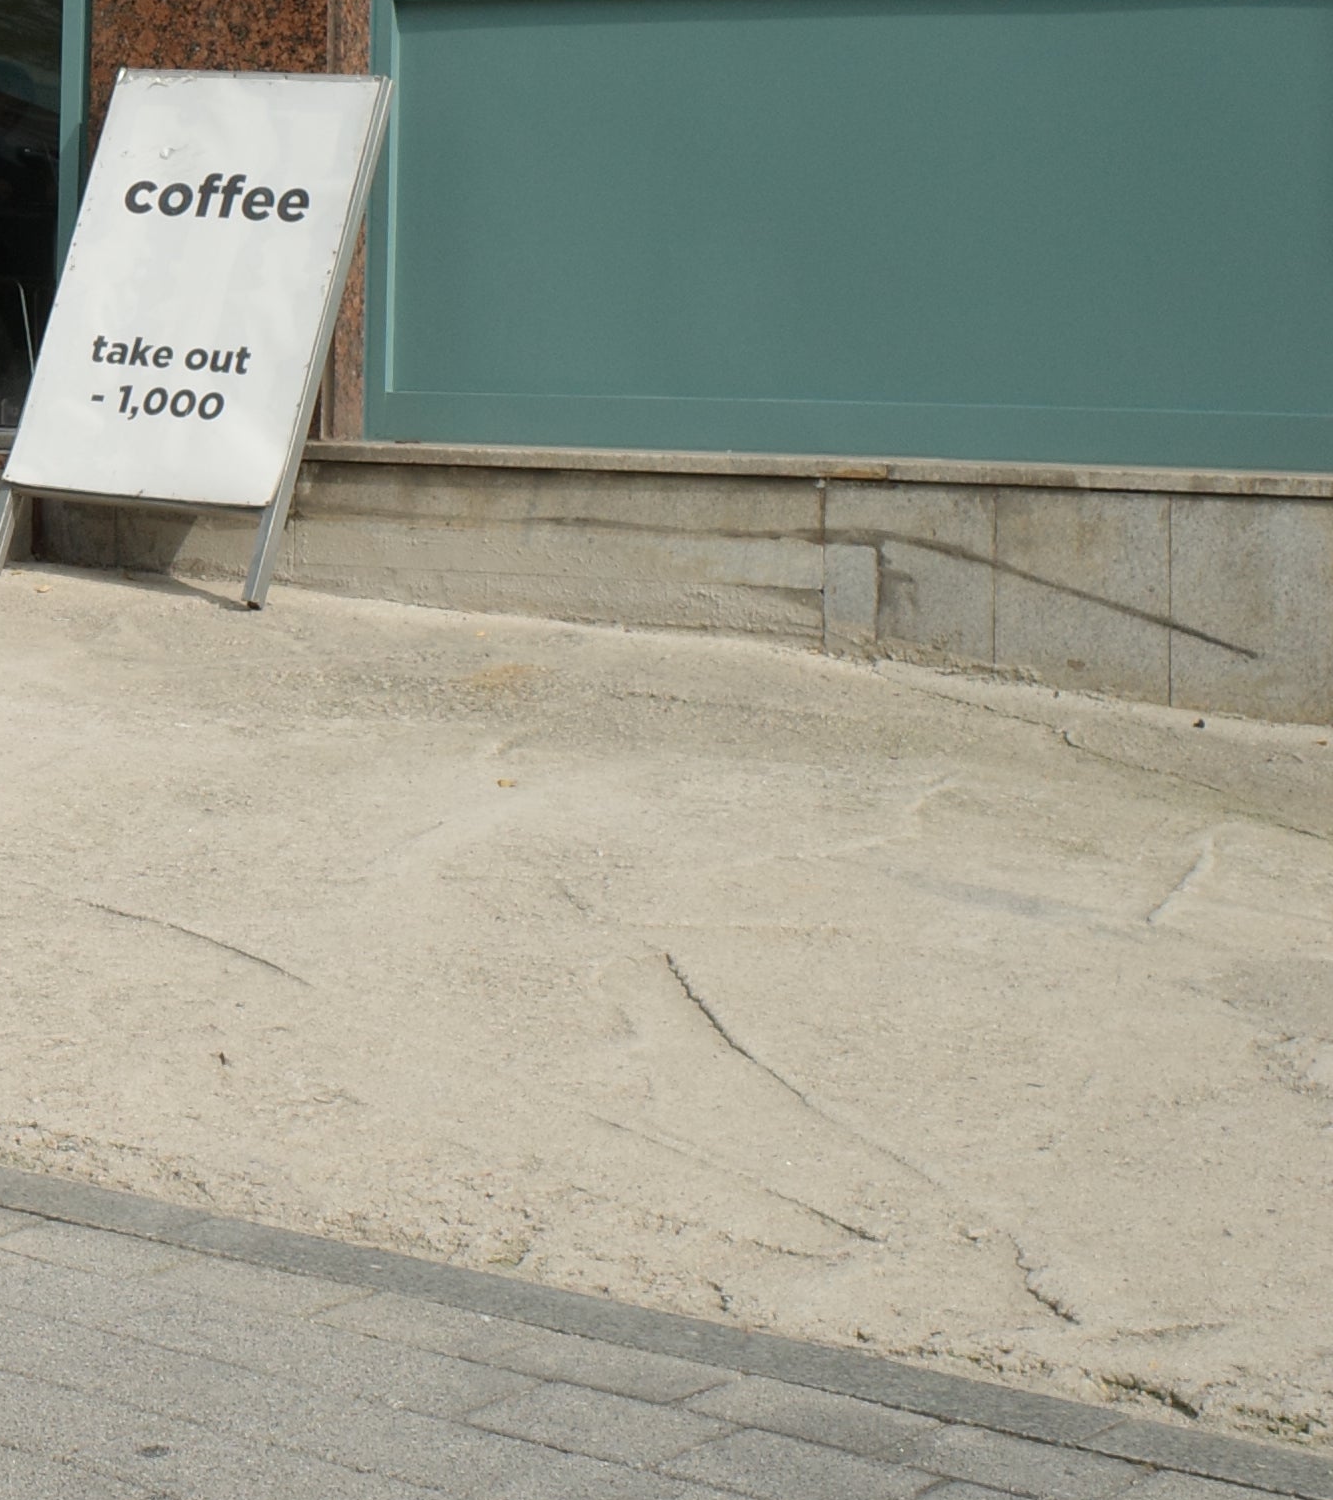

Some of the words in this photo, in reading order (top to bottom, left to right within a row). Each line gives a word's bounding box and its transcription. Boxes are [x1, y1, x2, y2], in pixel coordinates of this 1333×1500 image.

[124, 173, 311, 223] coffee
[90, 334, 174, 369] take
[184, 345, 252, 375] out
[117, 384, 226, 421] 1,000
